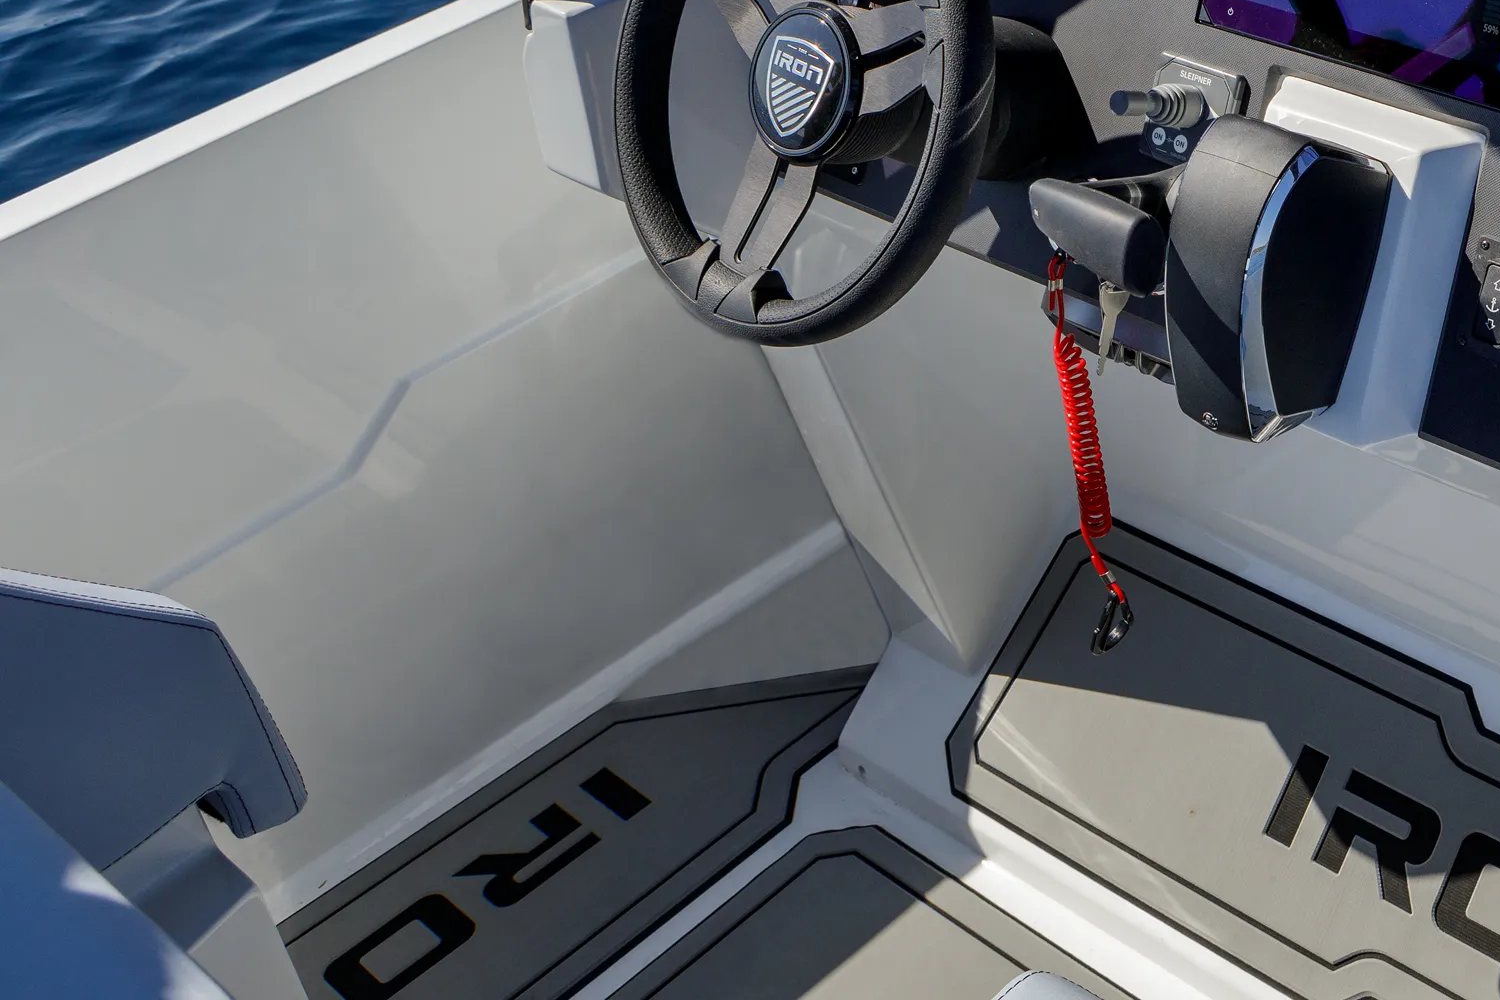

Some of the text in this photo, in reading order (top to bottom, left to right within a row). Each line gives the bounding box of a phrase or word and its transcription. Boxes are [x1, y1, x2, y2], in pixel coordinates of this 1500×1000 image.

[1482, 23, 1499, 36] 59%
[774, 49, 824, 85] IRON
[1179, 69, 1212, 87] SLEIPNER
[1153, 132, 1186, 149] ON ON
